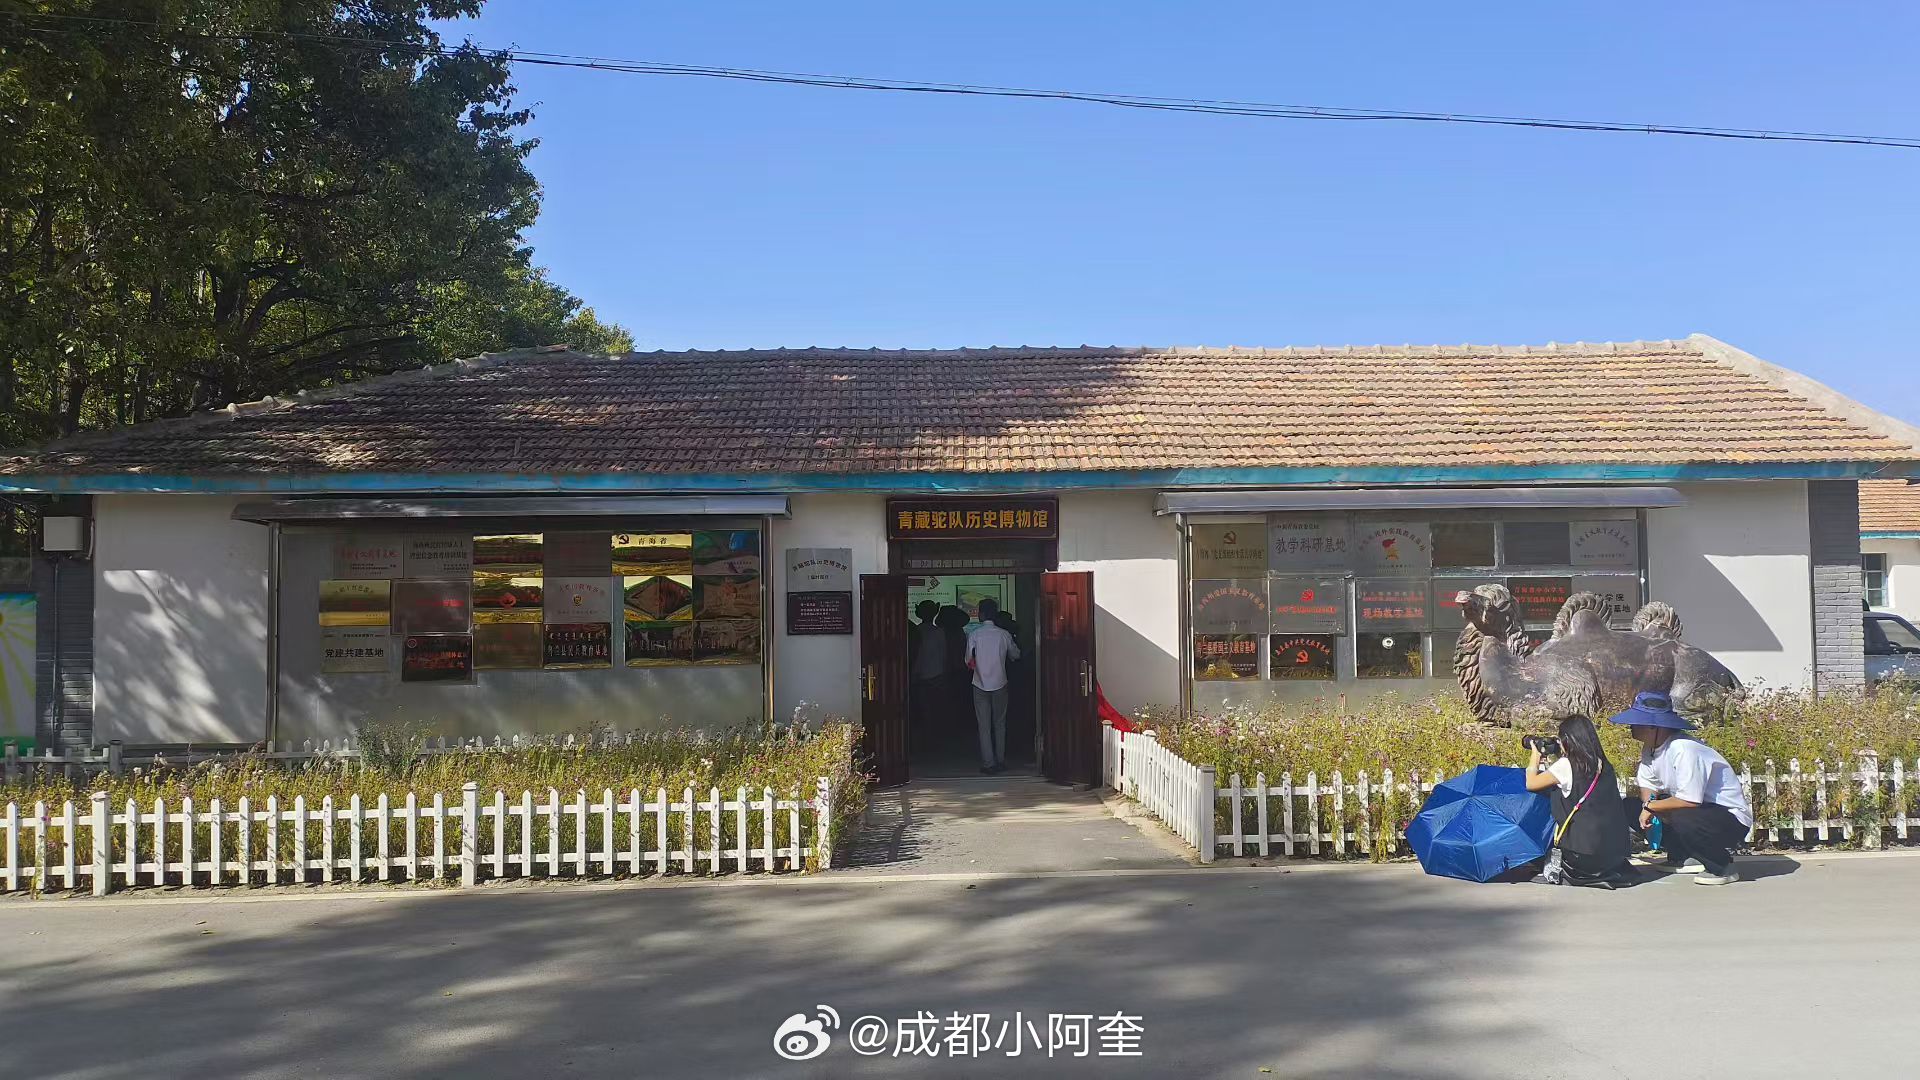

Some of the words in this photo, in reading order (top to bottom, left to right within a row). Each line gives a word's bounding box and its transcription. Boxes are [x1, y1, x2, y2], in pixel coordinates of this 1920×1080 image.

[897, 510, 1049, 529] 青藏驼队历史博物馆
[638, 537, 668, 545] 青海省
[1275, 536, 1347, 554] 教学科研基地
[325, 648, 384, 658] 党建共建基地
